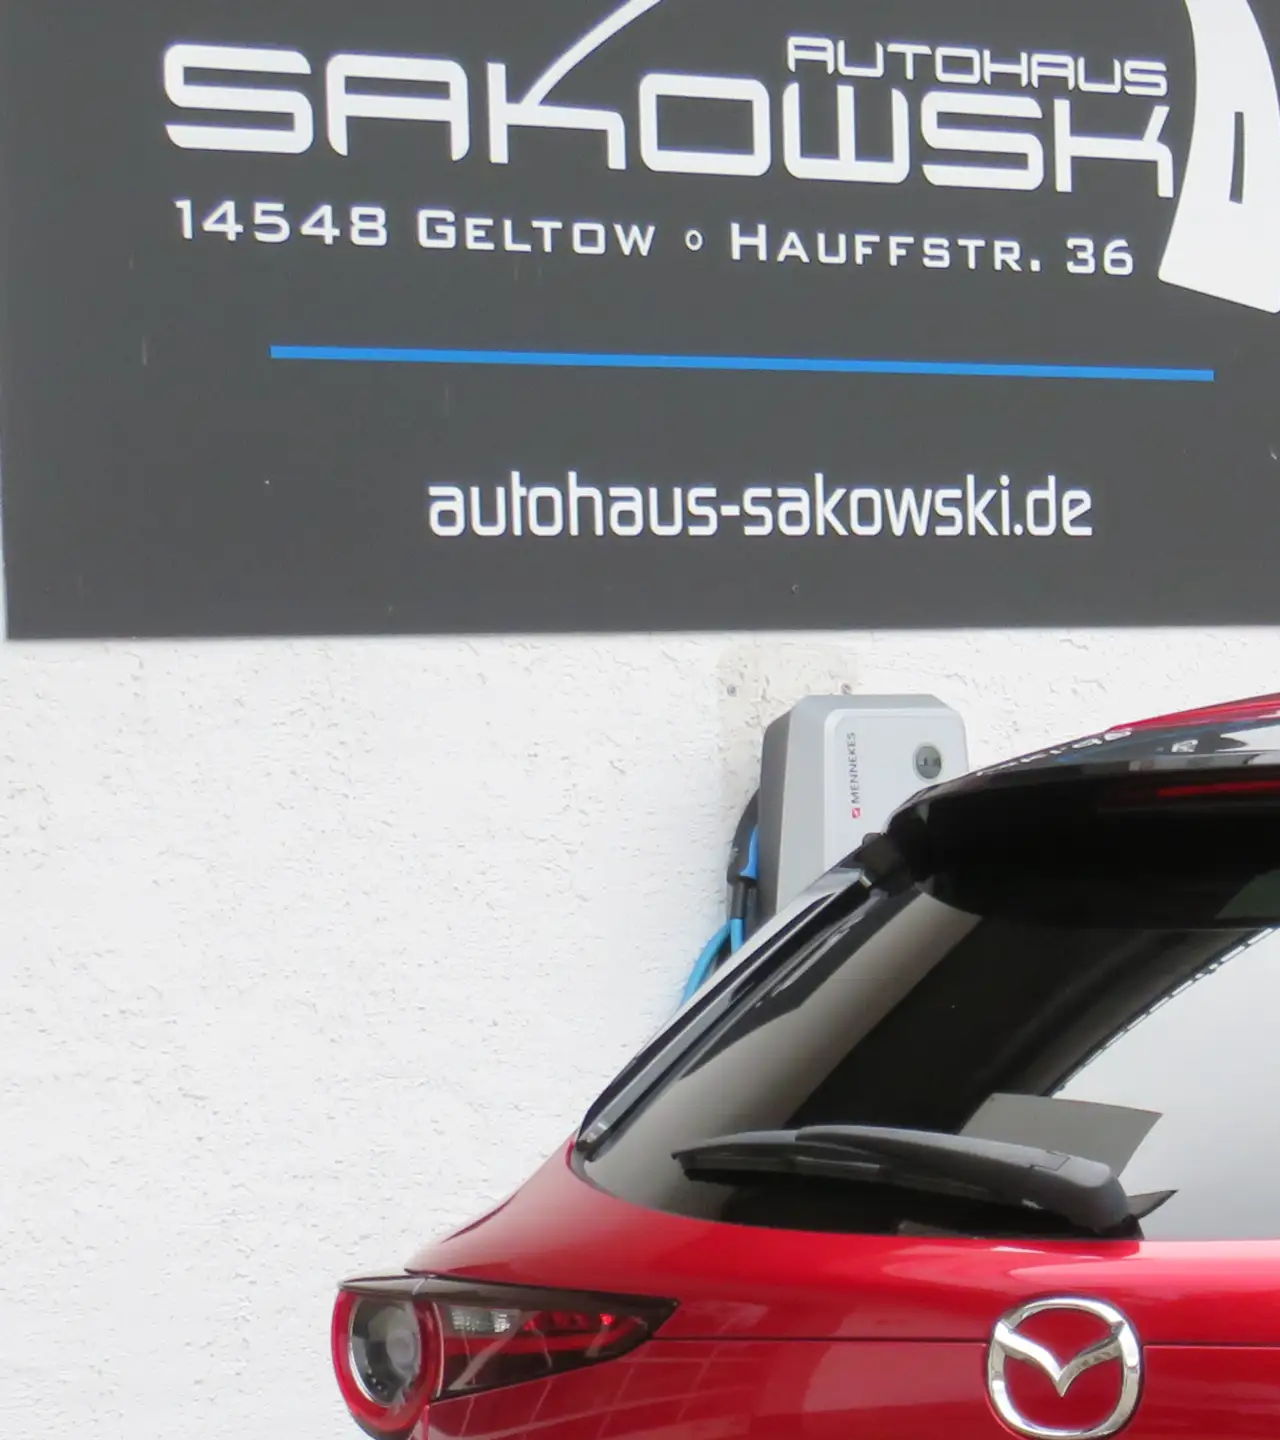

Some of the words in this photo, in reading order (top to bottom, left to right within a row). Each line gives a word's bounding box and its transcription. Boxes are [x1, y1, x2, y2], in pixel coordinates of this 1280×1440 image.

[787, 36, 1168, 97] AUTOHAUS
[174, 199, 388, 247] 14548
[418, 208, 656, 257] GELTOW
[730, 222, 1041, 272] HAUFFSTR.
[1066, 237, 1134, 275] 36
[429, 470, 1093, 537] autohaus-sakowski.de
[847, 731, 861, 805] MENNEKES
